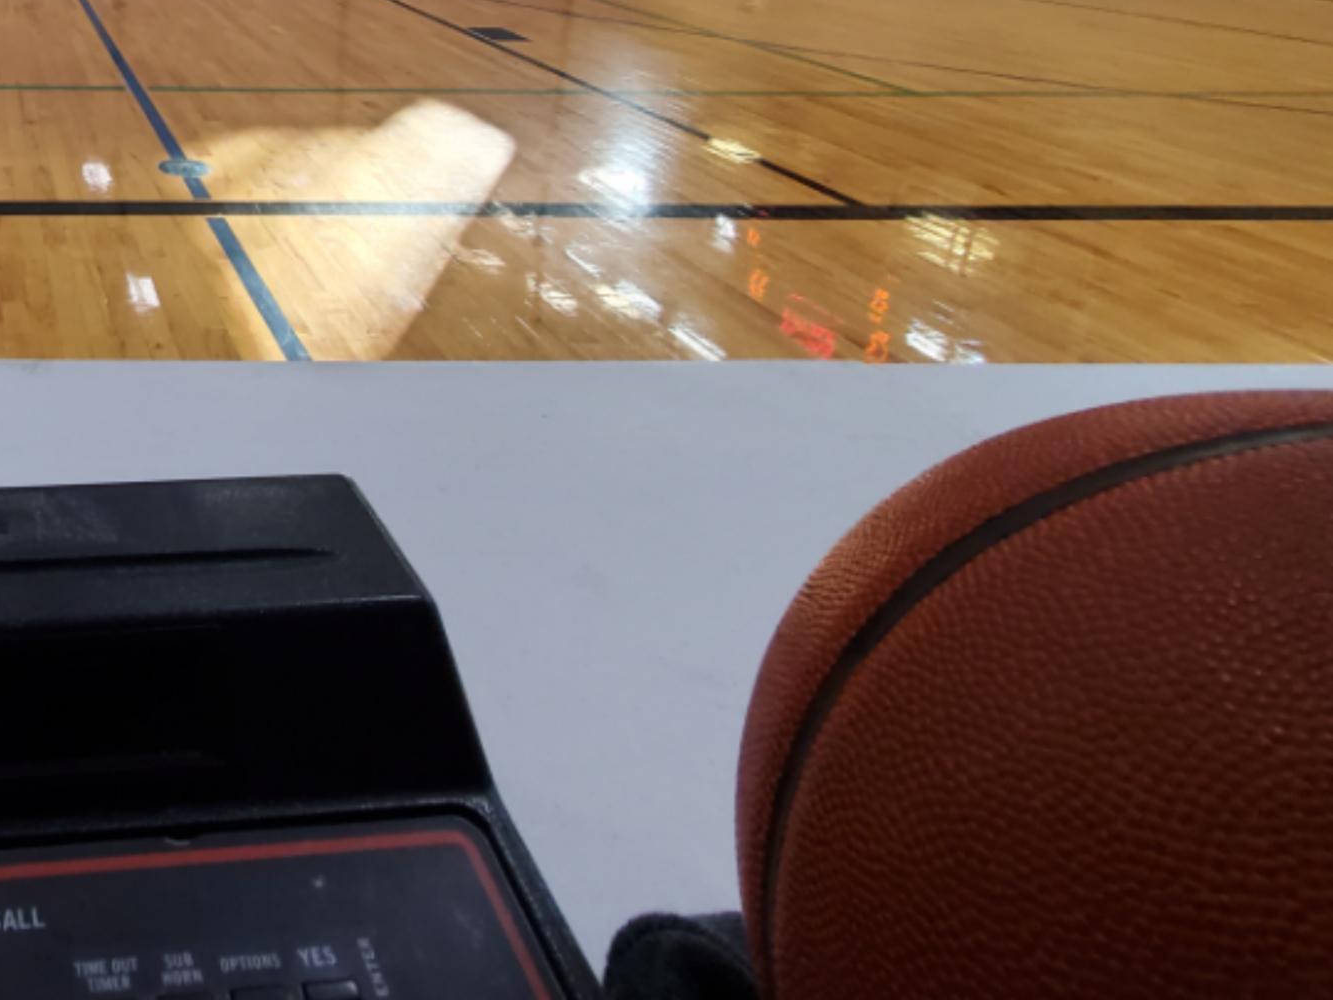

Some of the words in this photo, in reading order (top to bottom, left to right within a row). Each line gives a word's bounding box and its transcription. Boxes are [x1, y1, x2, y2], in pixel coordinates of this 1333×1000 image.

[163, 952, 195, 969] SUB
[219, 953, 282, 972] OPTIONS
[296, 946, 338, 968] YES
[73, 959, 107, 977] TIME
[112, 956, 138, 974] OUT
[87, 975, 132, 993] TIMER
[162, 969, 204, 986] HORN
